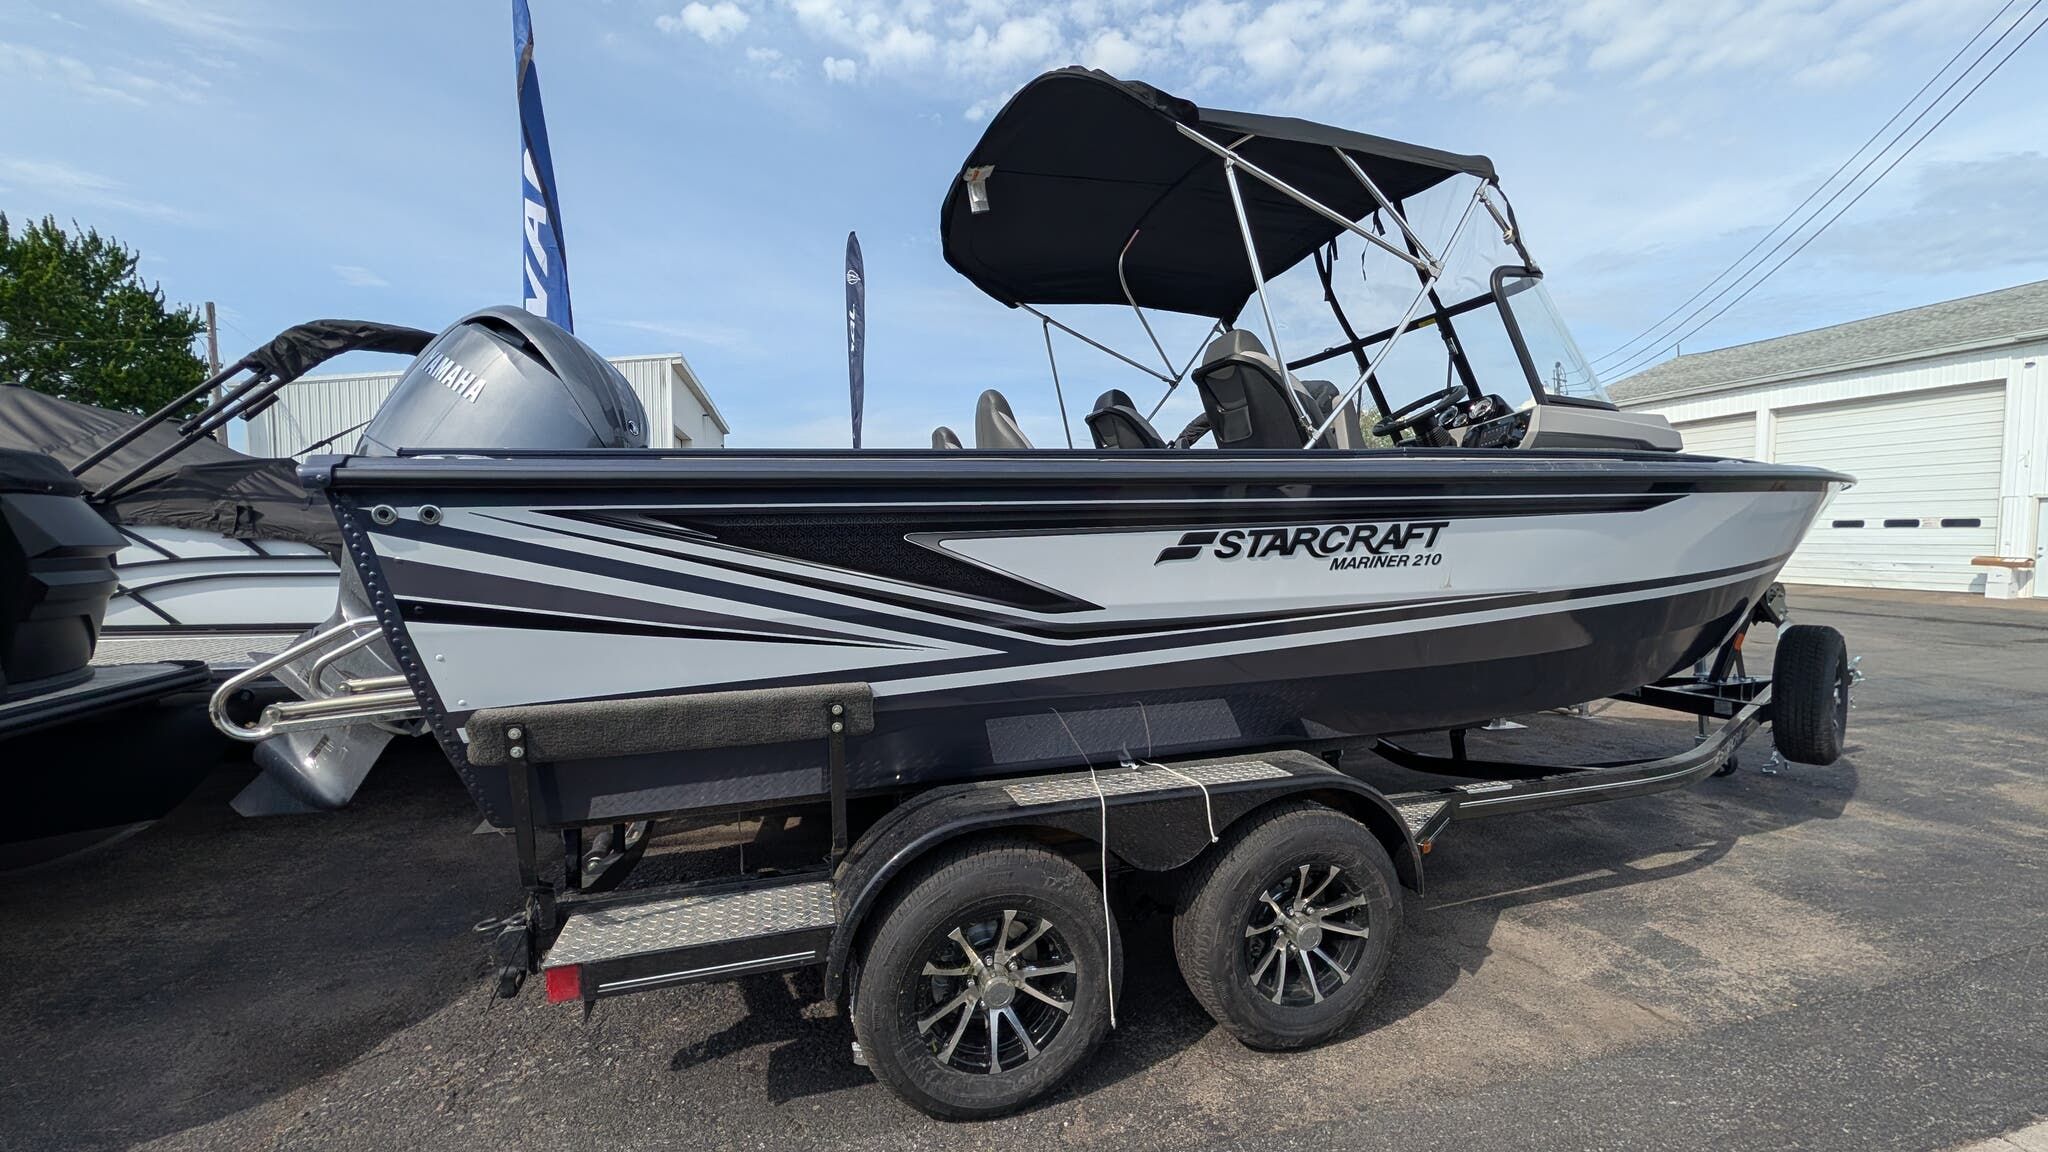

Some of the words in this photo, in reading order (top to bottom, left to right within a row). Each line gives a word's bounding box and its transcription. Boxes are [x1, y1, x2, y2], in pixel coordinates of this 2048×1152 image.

[421, 350, 488, 404] YAMAHA
[1213, 521, 1450, 559] STARCRAFT
[1329, 554, 1409, 571] MARINER
[1412, 553, 1443, 567] 210
